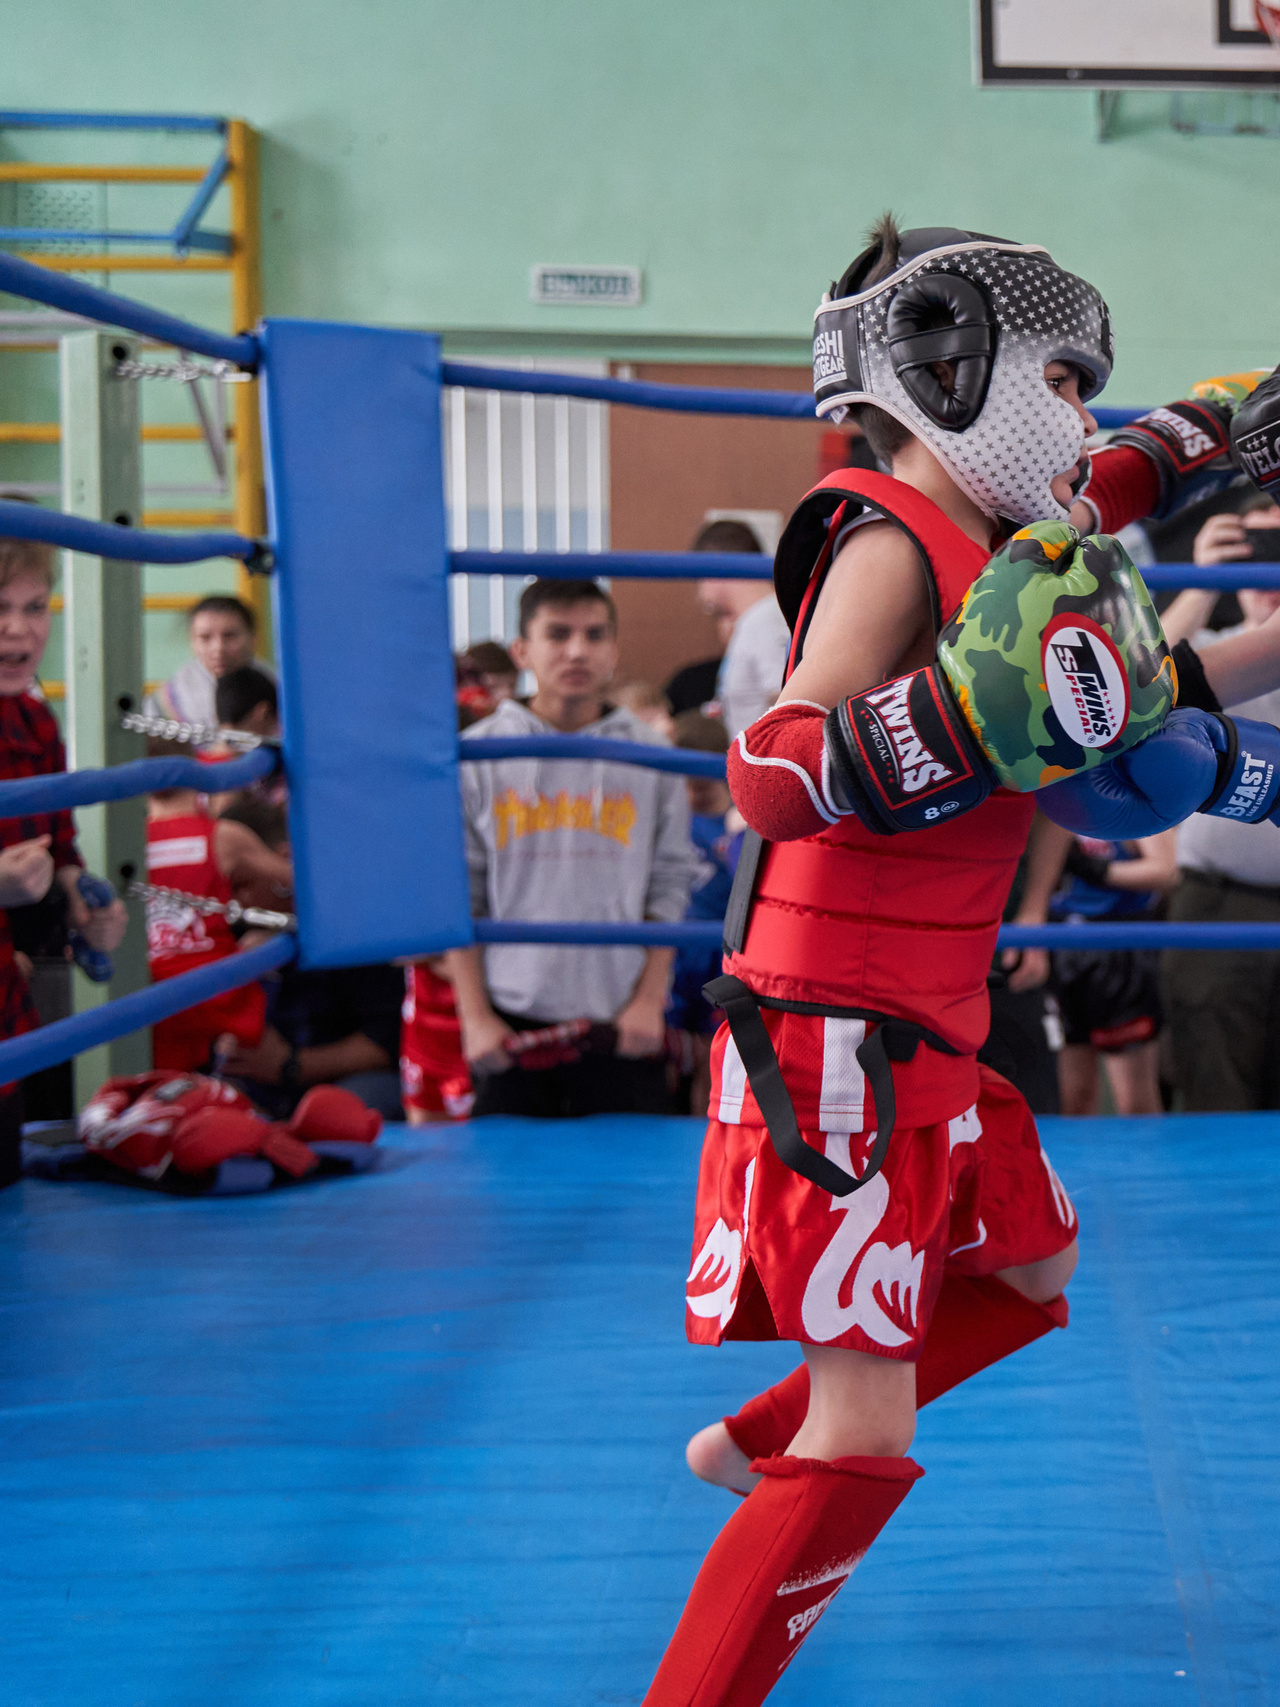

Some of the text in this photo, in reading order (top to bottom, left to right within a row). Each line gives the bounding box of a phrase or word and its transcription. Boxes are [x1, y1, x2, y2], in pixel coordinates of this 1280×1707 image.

[1050, 631, 1112, 737] TWINS
[1057, 647, 1092, 735] SPECIAL
[864, 676, 953, 792] TWINS
[868, 723, 891, 762] SPECIAL
[924, 807, 940, 820] 8
[1220, 753, 1266, 817] BEAST
[1256, 764, 1274, 805] UNLEASHED
